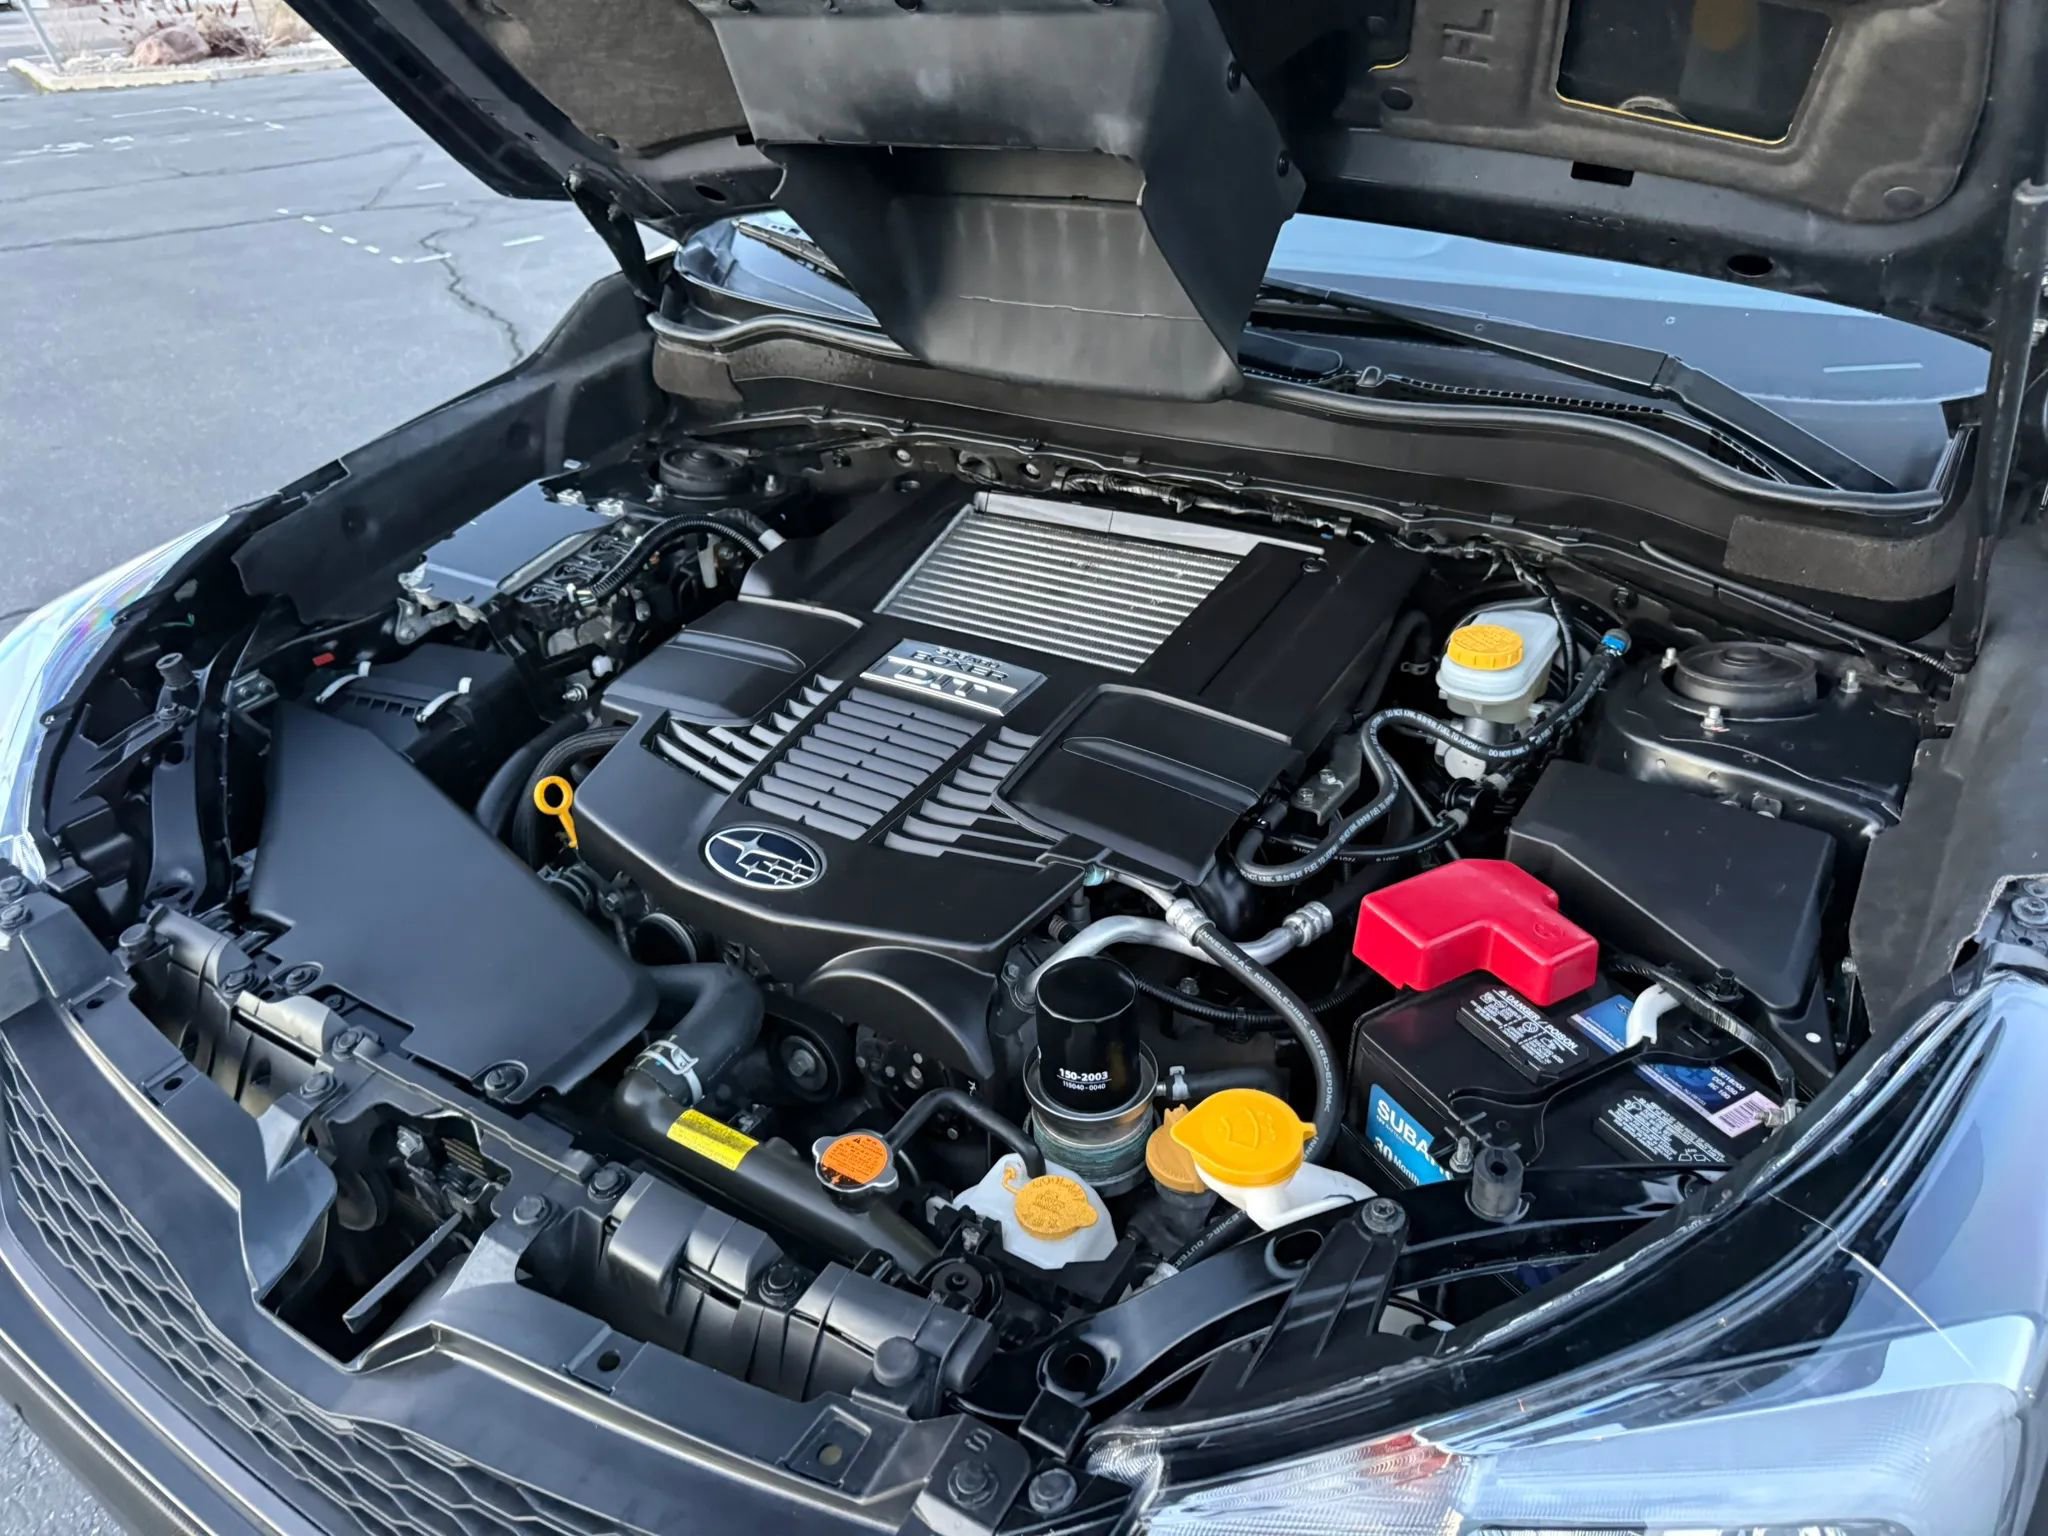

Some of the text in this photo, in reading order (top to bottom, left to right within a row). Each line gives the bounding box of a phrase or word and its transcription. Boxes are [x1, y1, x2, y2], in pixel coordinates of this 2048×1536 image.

[910, 650, 1009, 682] BOXER
[935, 646, 1001, 669] SUBARU
[893, 664, 988, 698] DIT
[1436, 723, 1450, 738] FUEL
[1488, 748, 1498, 758] DO
[1303, 862, 1319, 874] FUEL
[1505, 994, 1541, 1021] DANGER
[1544, 1024, 1579, 1049] POISON
[1059, 1067, 1108, 1082] 150-2003
[1712, 1076, 1725, 1087] CCA
[1377, 1099, 1451, 1179] SUBA
[1393, 1155, 1420, 1186] Month
